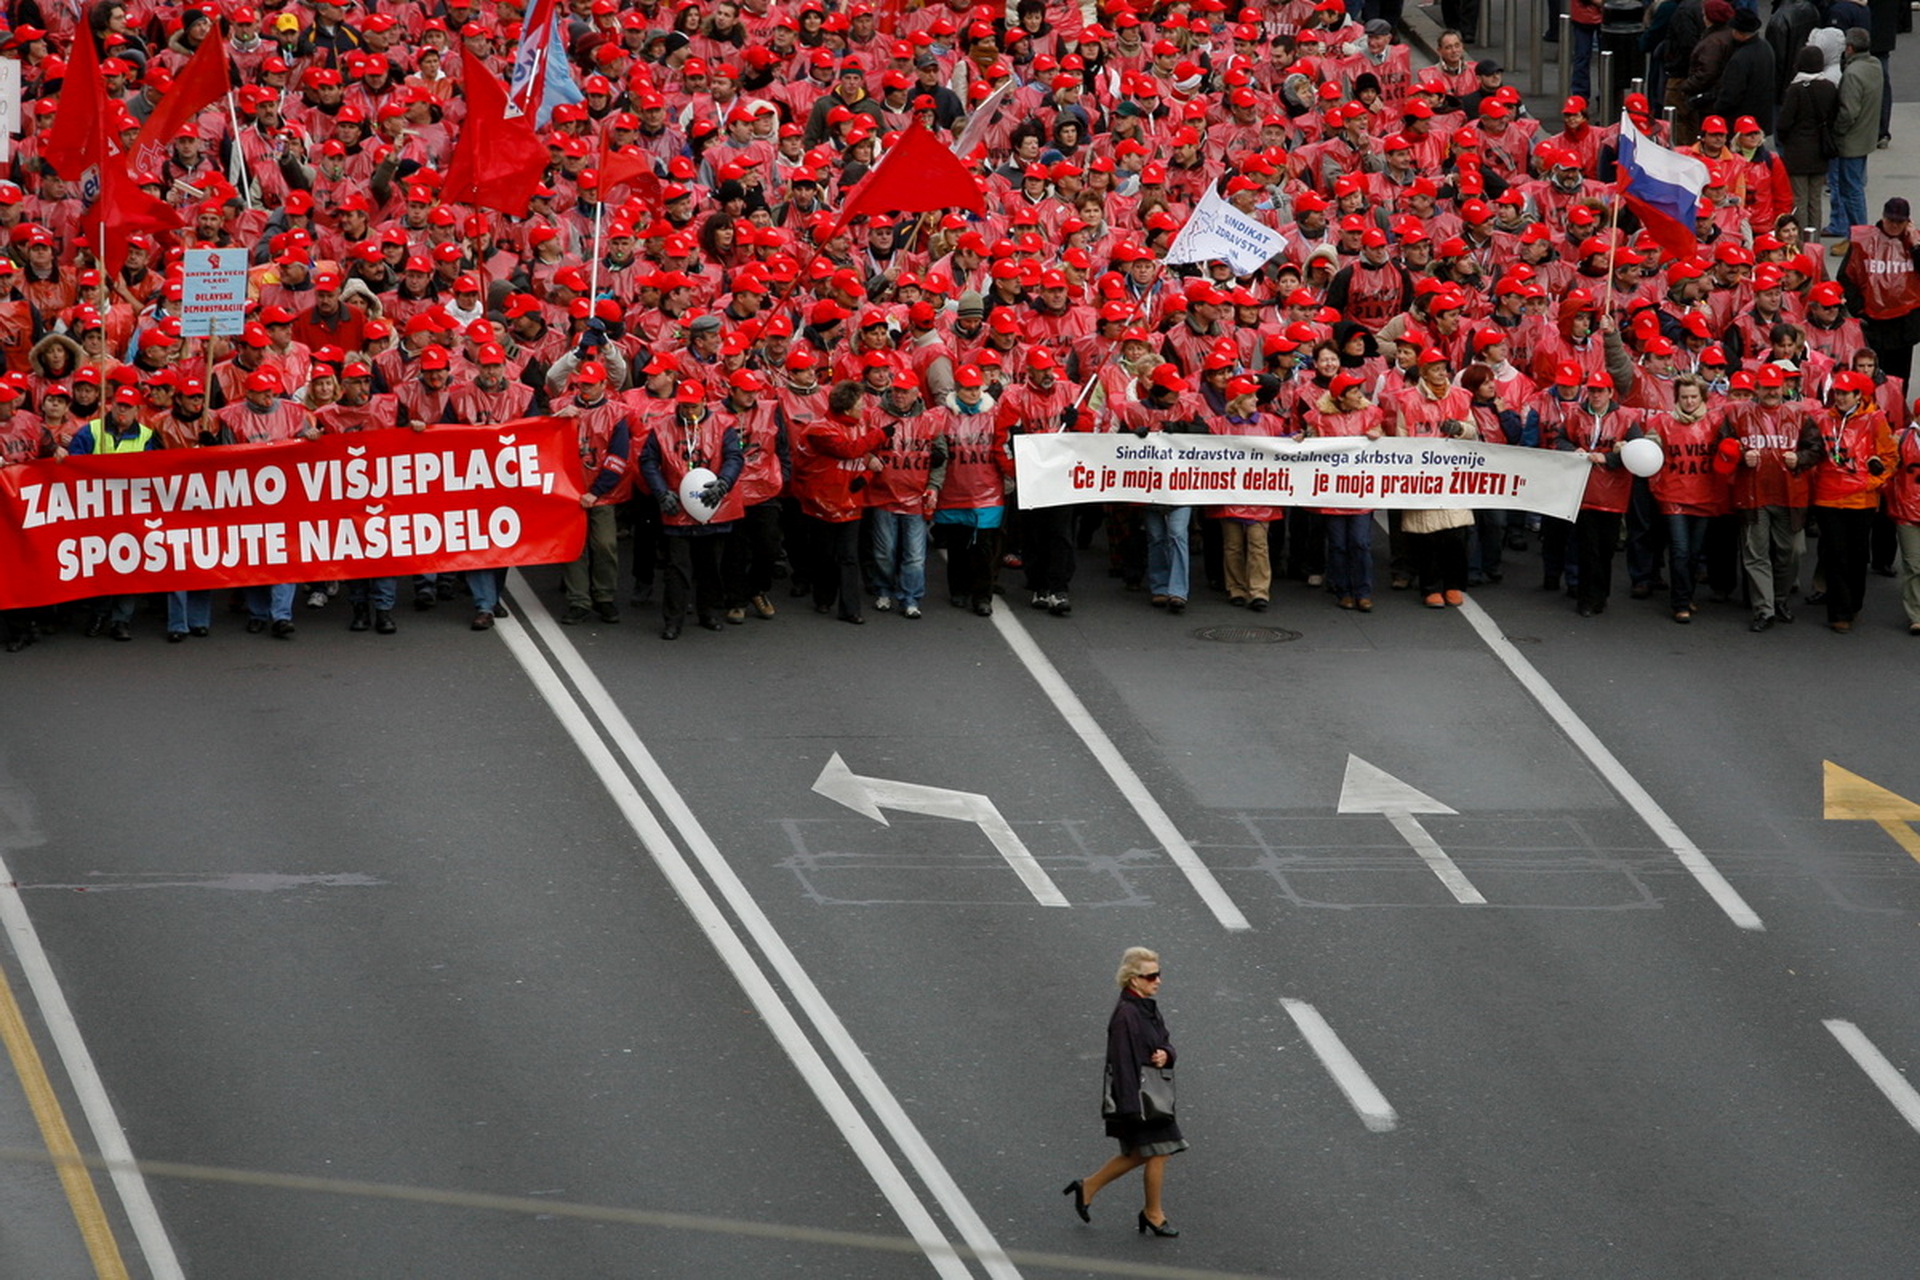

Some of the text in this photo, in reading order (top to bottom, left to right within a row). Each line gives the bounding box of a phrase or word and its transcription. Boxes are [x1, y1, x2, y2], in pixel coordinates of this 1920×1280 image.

[1215, 225, 1268, 260] ZDRAVSTVA
[1224, 214, 1271, 244] SINDIKAT
[184, 304, 243, 313] DEMONSTRACIJE
[195, 292, 233, 301] DELAVSKE
[1116, 445, 1486, 469] Sindikat zdravstva in socialnega skrbstva Slovenije
[1100, 465, 1116, 493] je
[1122, 466, 1162, 494] moja
[1169, 463, 1237, 491] dolžnost
[1243, 466, 1294, 497] delati,
[1312, 468, 1329, 497] je
[1336, 469, 1374, 498] moja
[1381, 470, 1443, 498] pravica
[1450, 467, 1506, 496] ŽIVETI
[20, 465, 287, 529] ZAHTEVAMO
[57, 517, 287, 582] SPOŠTUJTE
